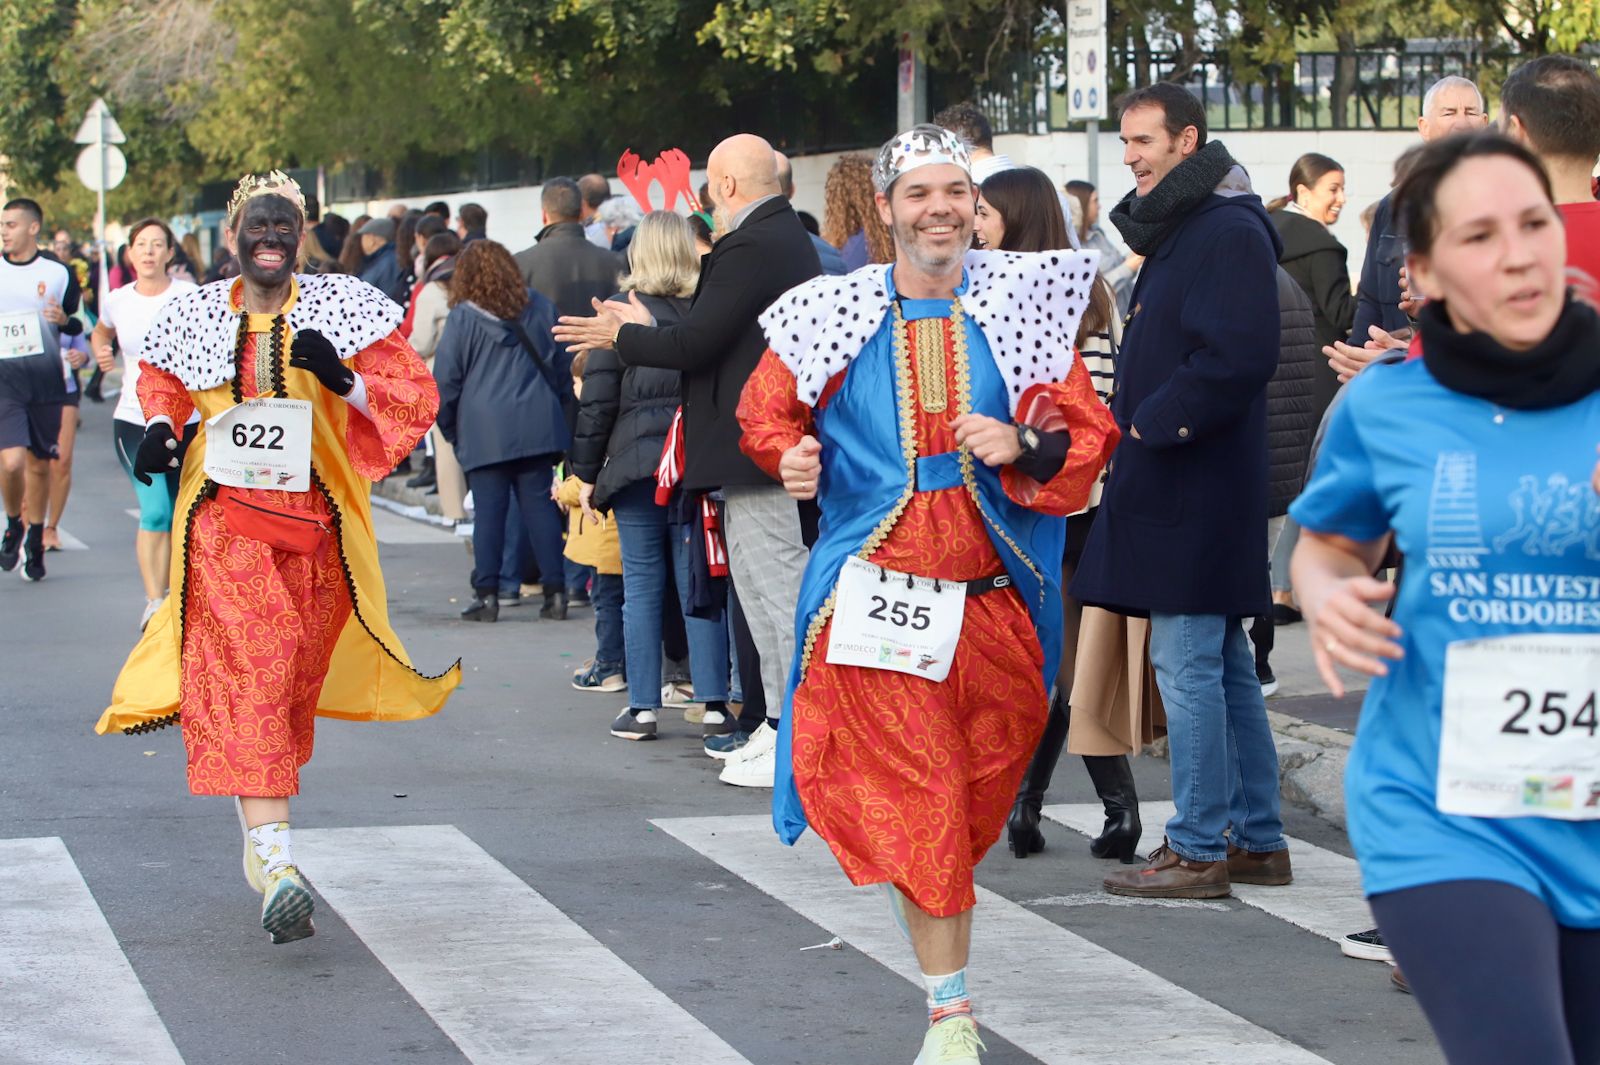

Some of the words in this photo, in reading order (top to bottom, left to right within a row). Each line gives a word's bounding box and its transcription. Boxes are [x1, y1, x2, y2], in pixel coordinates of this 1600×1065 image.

[3, 324, 27, 338] 761
[232, 423, 285, 450] 622
[1429, 572, 1488, 597] SAN
[1493, 573, 1600, 599] SILVEST
[868, 595, 931, 631] 255
[843, 643, 877, 654] IMDECO
[1500, 689, 1599, 736] 254
